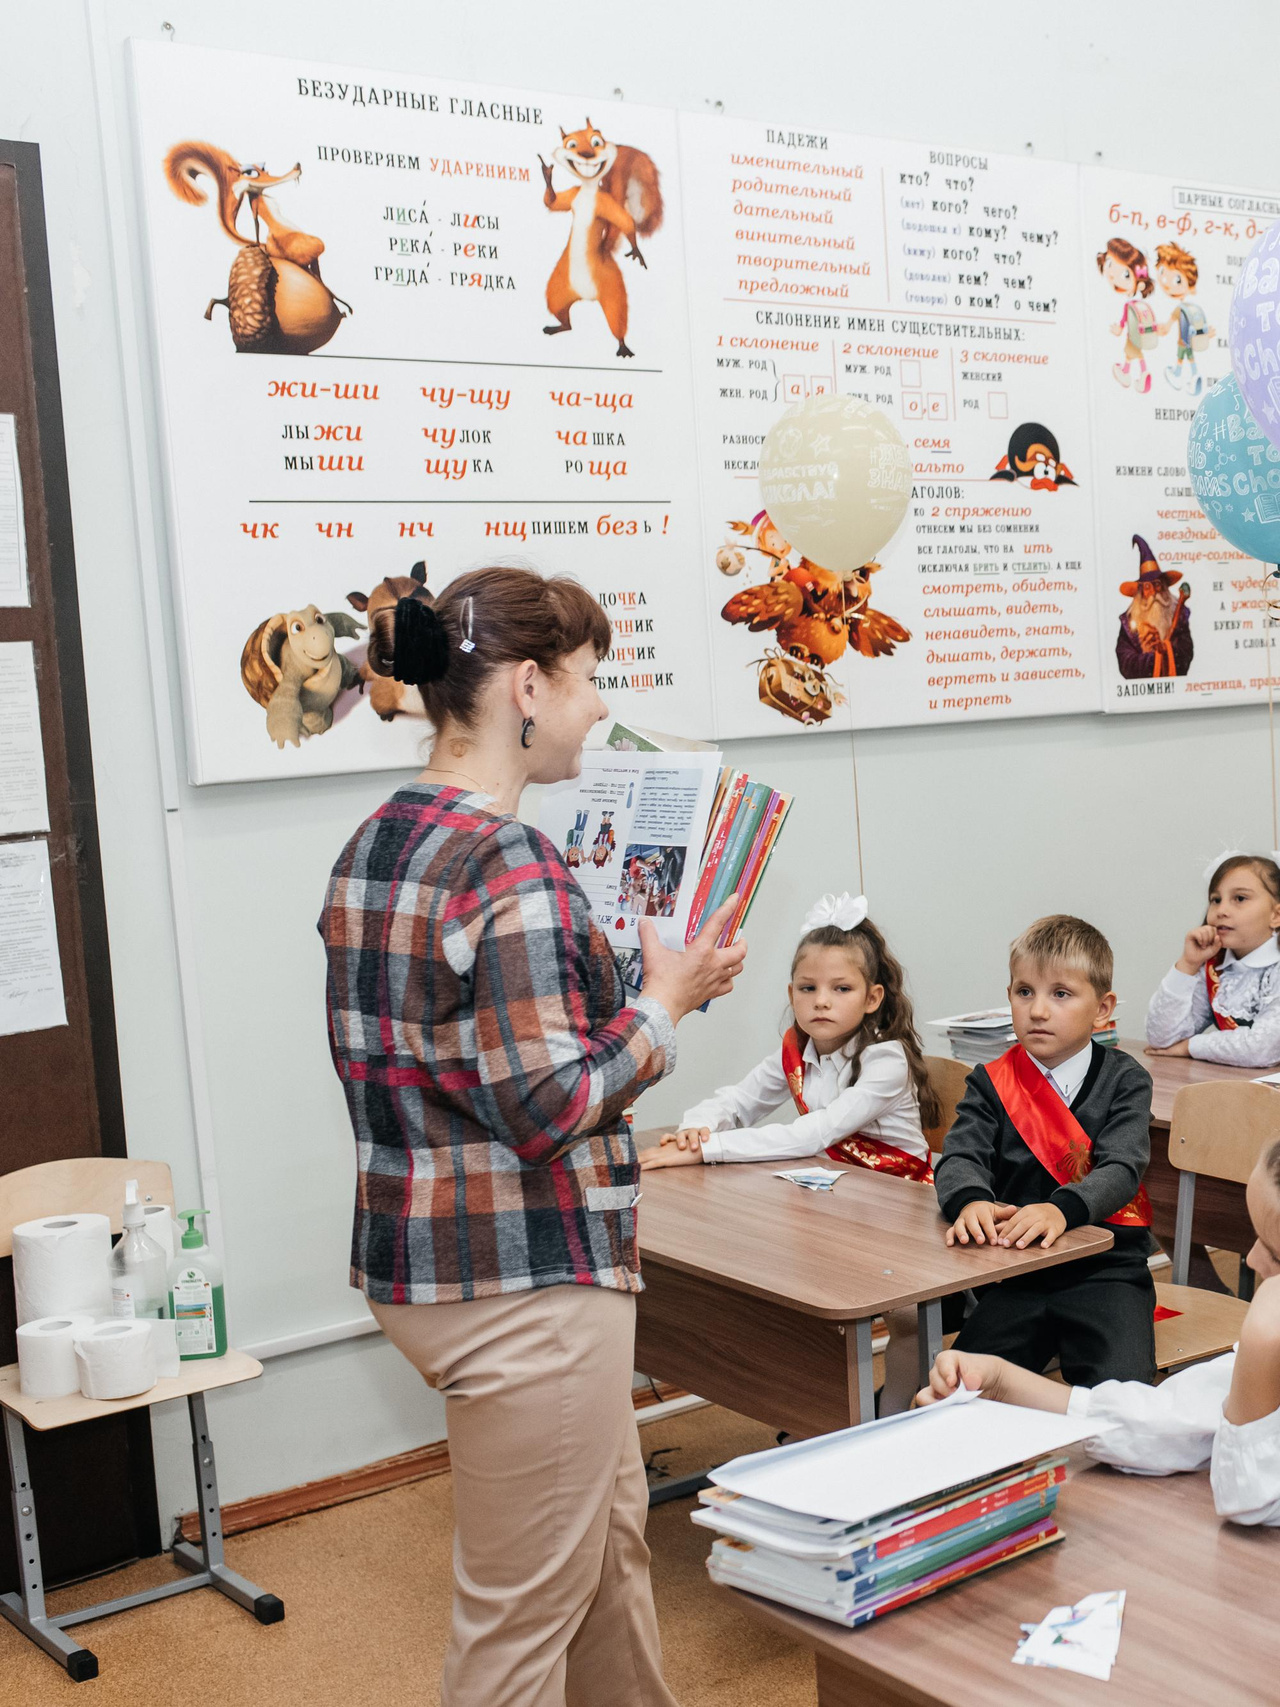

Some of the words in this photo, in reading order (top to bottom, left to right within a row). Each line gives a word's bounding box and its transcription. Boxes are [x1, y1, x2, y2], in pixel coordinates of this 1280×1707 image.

[296, 77, 440, 112] БЕЗУДАРНЫЕ
[449, 97, 544, 126] ГЛАСНЫЕ
[766, 128, 830, 151] ПАДЕЖИ
[929, 151, 989, 171] ВОПРОСЫ
[317, 145, 421, 171] ПРОВЕРЯЕМ
[429, 157, 531, 182] УДАРЕНИЕМ
[730, 153, 865, 180] именительный
[899, 171, 931, 188] кто?
[945, 177, 976, 193] что?
[731, 176, 853, 202] родительный
[931, 199, 969, 215] кого?
[983, 205, 1019, 220] чего?
[1178, 191, 1225, 209] ПАРНЫЕ
[733, 199, 835, 225] дательный
[968, 225, 1008, 243] кому?
[1021, 230, 1060, 248] чему?
[1108, 203, 1150, 232] б-п,
[1156, 211, 1199, 238] в-ф,
[735, 227, 856, 251] винительный
[942, 246, 980, 262] кого?
[993, 251, 1023, 266] что?
[736, 253, 872, 277] творительный
[957, 271, 990, 286] кем?
[1003, 275, 1034, 290] чем?
[738, 276, 850, 299] предложный
[968, 294, 1001, 309] ком?
[1028, 298, 1059, 314] чем?
[755, 310, 842, 330] СКЛОНЕНИЕ
[847, 316, 885, 333] ИМЕН
[891, 319, 1026, 342] СУЩЕСТВИТЕЛЬНЫХ:
[716, 335, 725, 347] 1
[729, 336, 820, 353] склонение
[842, 342, 852, 354] 2
[857, 343, 940, 360] склонение
[716, 358, 746, 369] МУЖ.
[748, 359, 769, 371] РОД
[960, 350, 970, 363] 3
[973, 351, 1050, 366] склонение
[845, 364, 871, 375] МУЖ.
[874, 365, 893, 377] РОД
[961, 371, 1003, 382] ЖЕНСКИЙ
[267, 379, 381, 401] жи-ши
[419, 384, 512, 410] чу-щу
[548, 390, 635, 410] ча-ща
[719, 387, 745, 399] ЖЕН.
[749, 389, 770, 401] РОД
[876, 394, 894, 405] РОД
[962, 399, 980, 410] РОД
[1213, 413, 1266, 444] #Ba
[913, 436, 951, 450] семя
[911, 461, 965, 474] альто
[1115, 465, 1153, 477] ИЗМЕНИ
[1157, 466, 1187, 478] СЛОВО
[911, 485, 966, 500] АГОЛОВ:
[913, 507, 925, 518] КО
[930, 506, 941, 518] 2
[944, 506, 1033, 521] спряжению
[239, 520, 280, 540] чк
[315, 520, 355, 539] чн
[397, 520, 436, 539] нч
[484, 520, 528, 543] нщ
[530, 519, 591, 537] ПИШЕМ
[596, 513, 639, 536] без
[915, 525, 956, 535] ОТНЕСЕМ
[959, 525, 974, 534] МЫ
[977, 525, 993, 534] БЕЗ
[995, 524, 1041, 534] СОМНЕНИЯ
[917, 545, 934, 555] ВСЕ
[936, 544, 982, 556] ГЛАГОЛЫ,
[983, 544, 1000, 554] ЧТО
[1003, 544, 1015, 554] НА
[1023, 542, 1054, 555] ить
[917, 563, 971, 574] (ИСКЛЮЧАЯ
[973, 562, 1000, 575] БРИТЬ
[1065, 560, 1083, 571] ЕЩЕ
[922, 583, 1009, 598] смотреть,
[1011, 578, 1079, 594] обидеть,
[923, 605, 1003, 619] слышать,
[1005, 600, 1065, 616] видеть,
[610, 619, 654, 634] ЧНИК
[925, 624, 1022, 642] ненавидеть,
[1024, 624, 1076, 638] гнать,
[1213, 620, 1241, 632] БУКВУ
[926, 648, 997, 665] дышать,
[1000, 645, 1074, 663] держать,
[596, 672, 674, 691] БМАНЩИК
[927, 673, 998, 690] вертеть
[1001, 672, 1010, 683] и
[1013, 667, 1087, 682] зависеть,
[1116, 682, 1176, 698] ЗАПОМНИ!
[1185, 677, 1247, 694] лестница,
[929, 698, 939, 710] и
[942, 694, 1013, 711] терпеть
